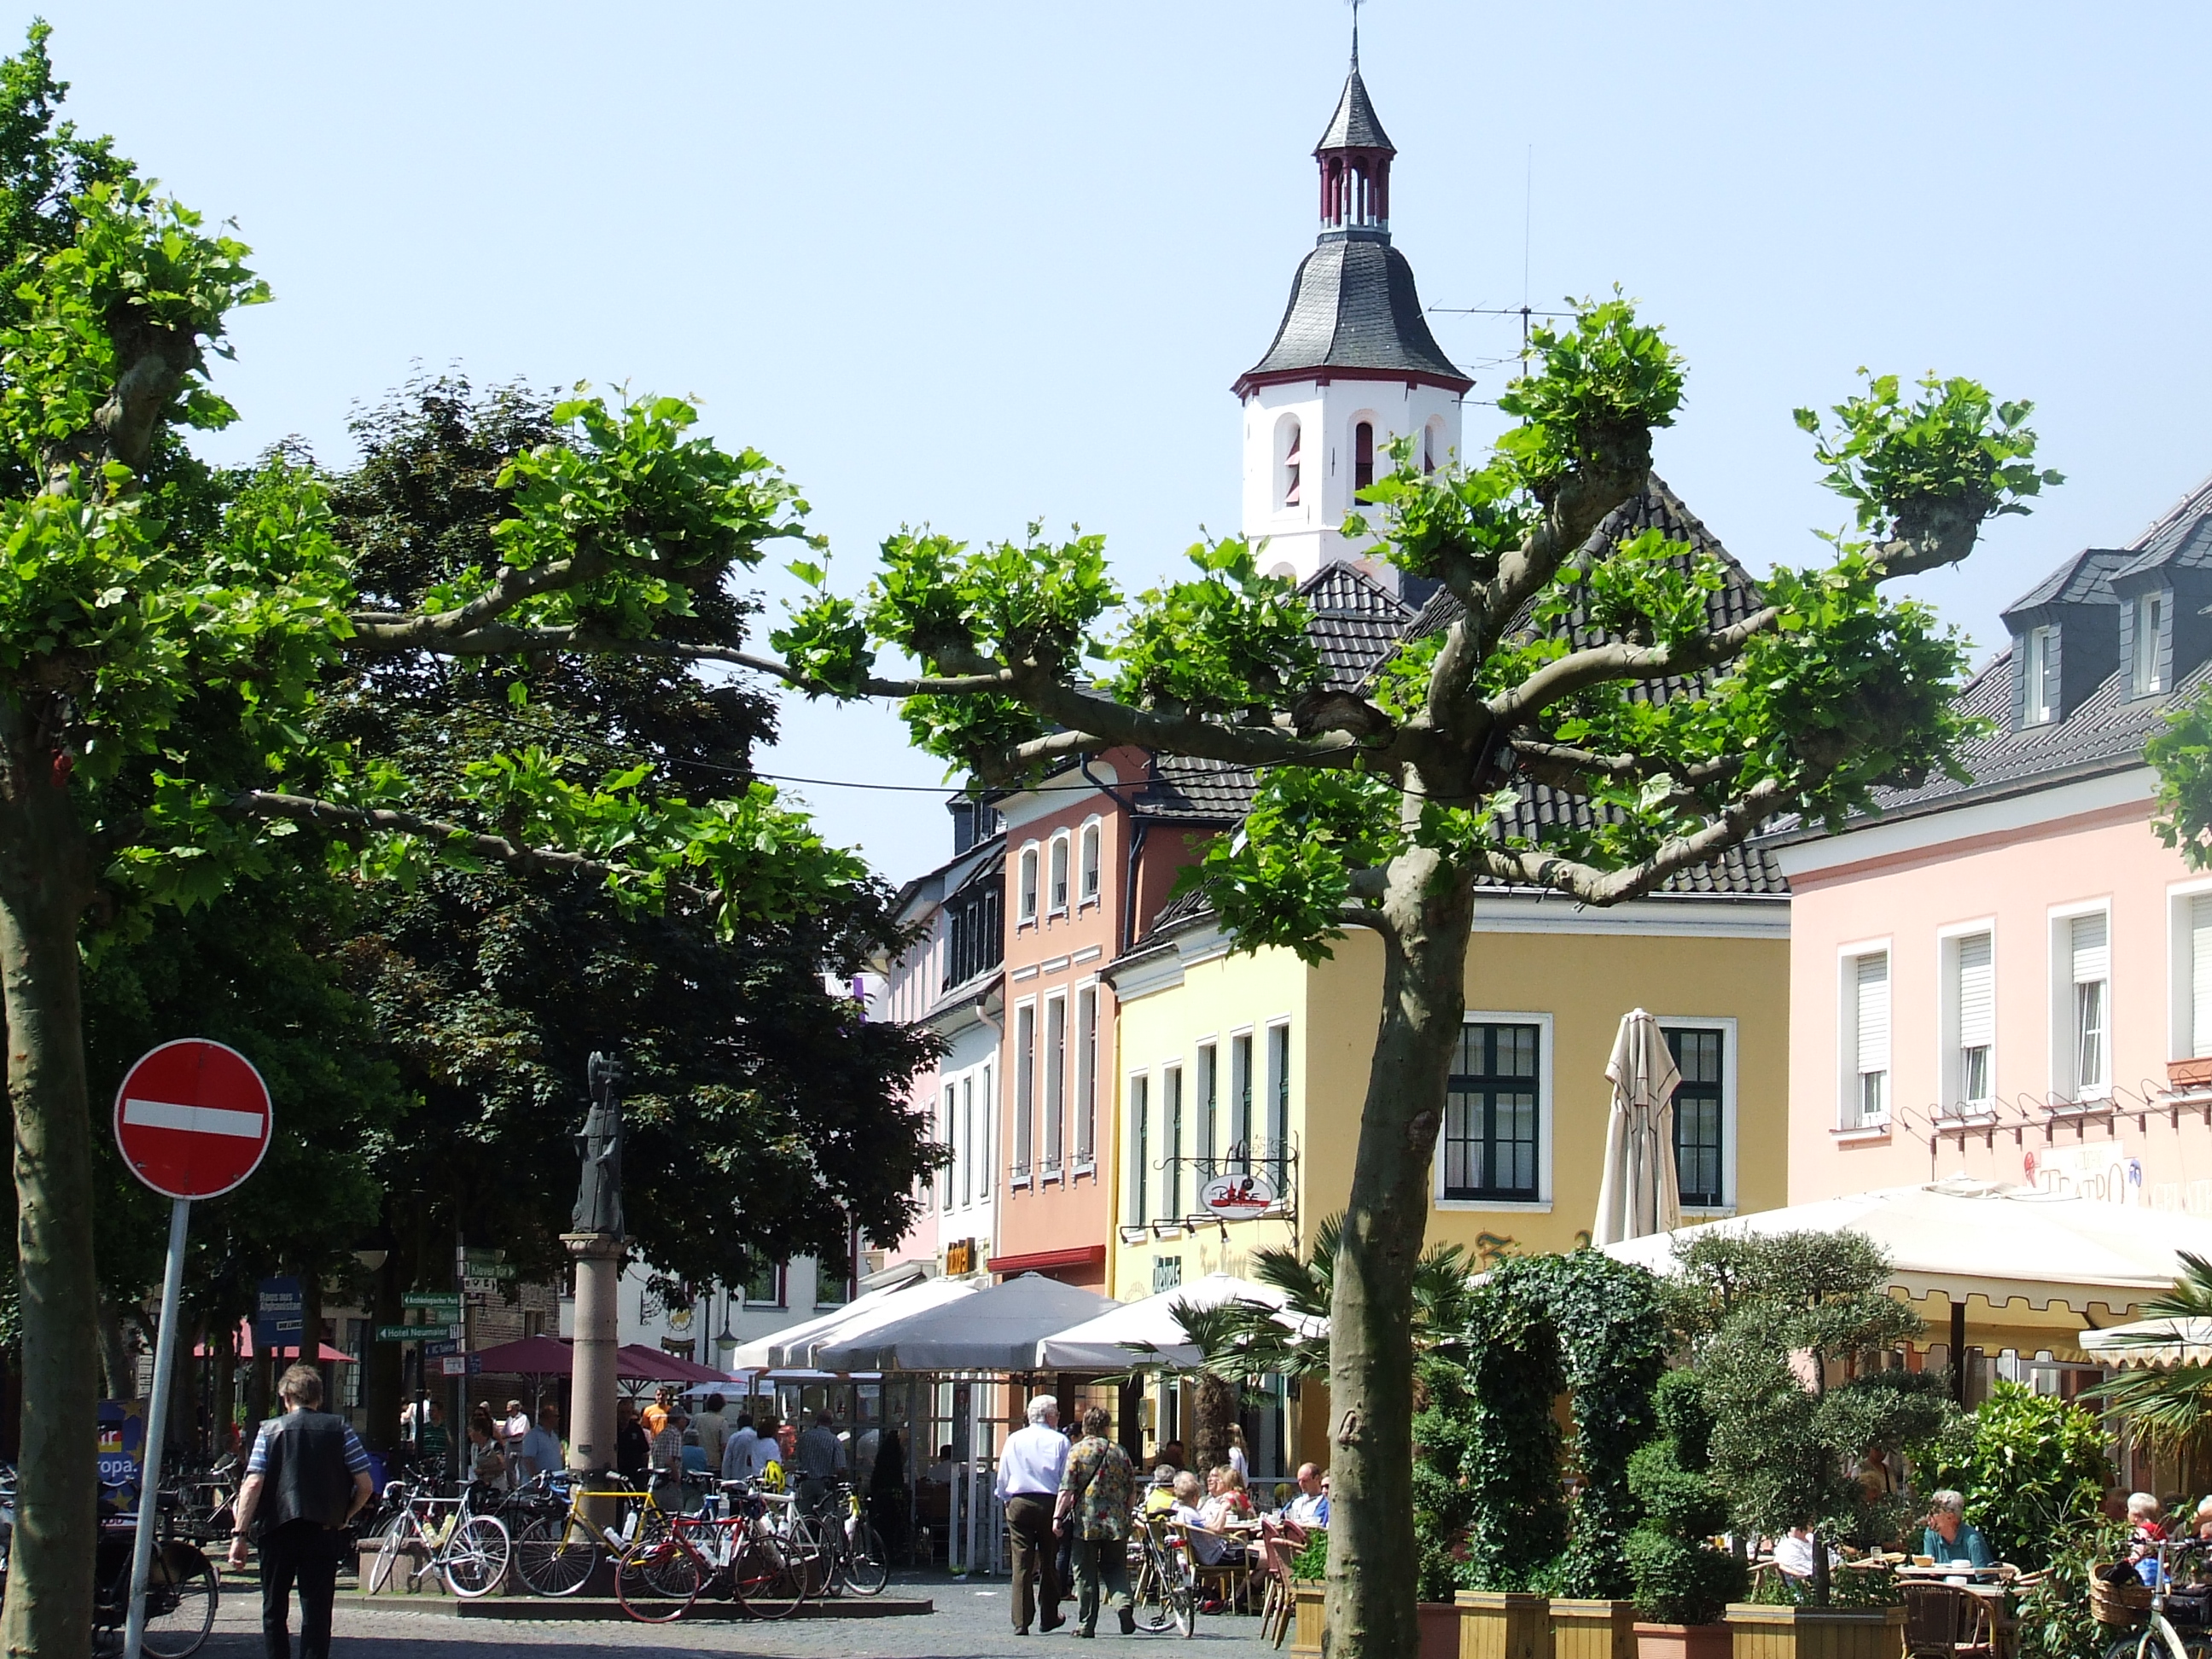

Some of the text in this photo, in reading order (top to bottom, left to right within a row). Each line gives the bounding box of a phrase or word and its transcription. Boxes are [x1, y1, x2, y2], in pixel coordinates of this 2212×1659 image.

[471, 1265, 507, 1277] Klever Tor
[259, 1301, 301, 1312] Afghanistan
[388, 1327, 448, 1338] Hotel Neumaier
